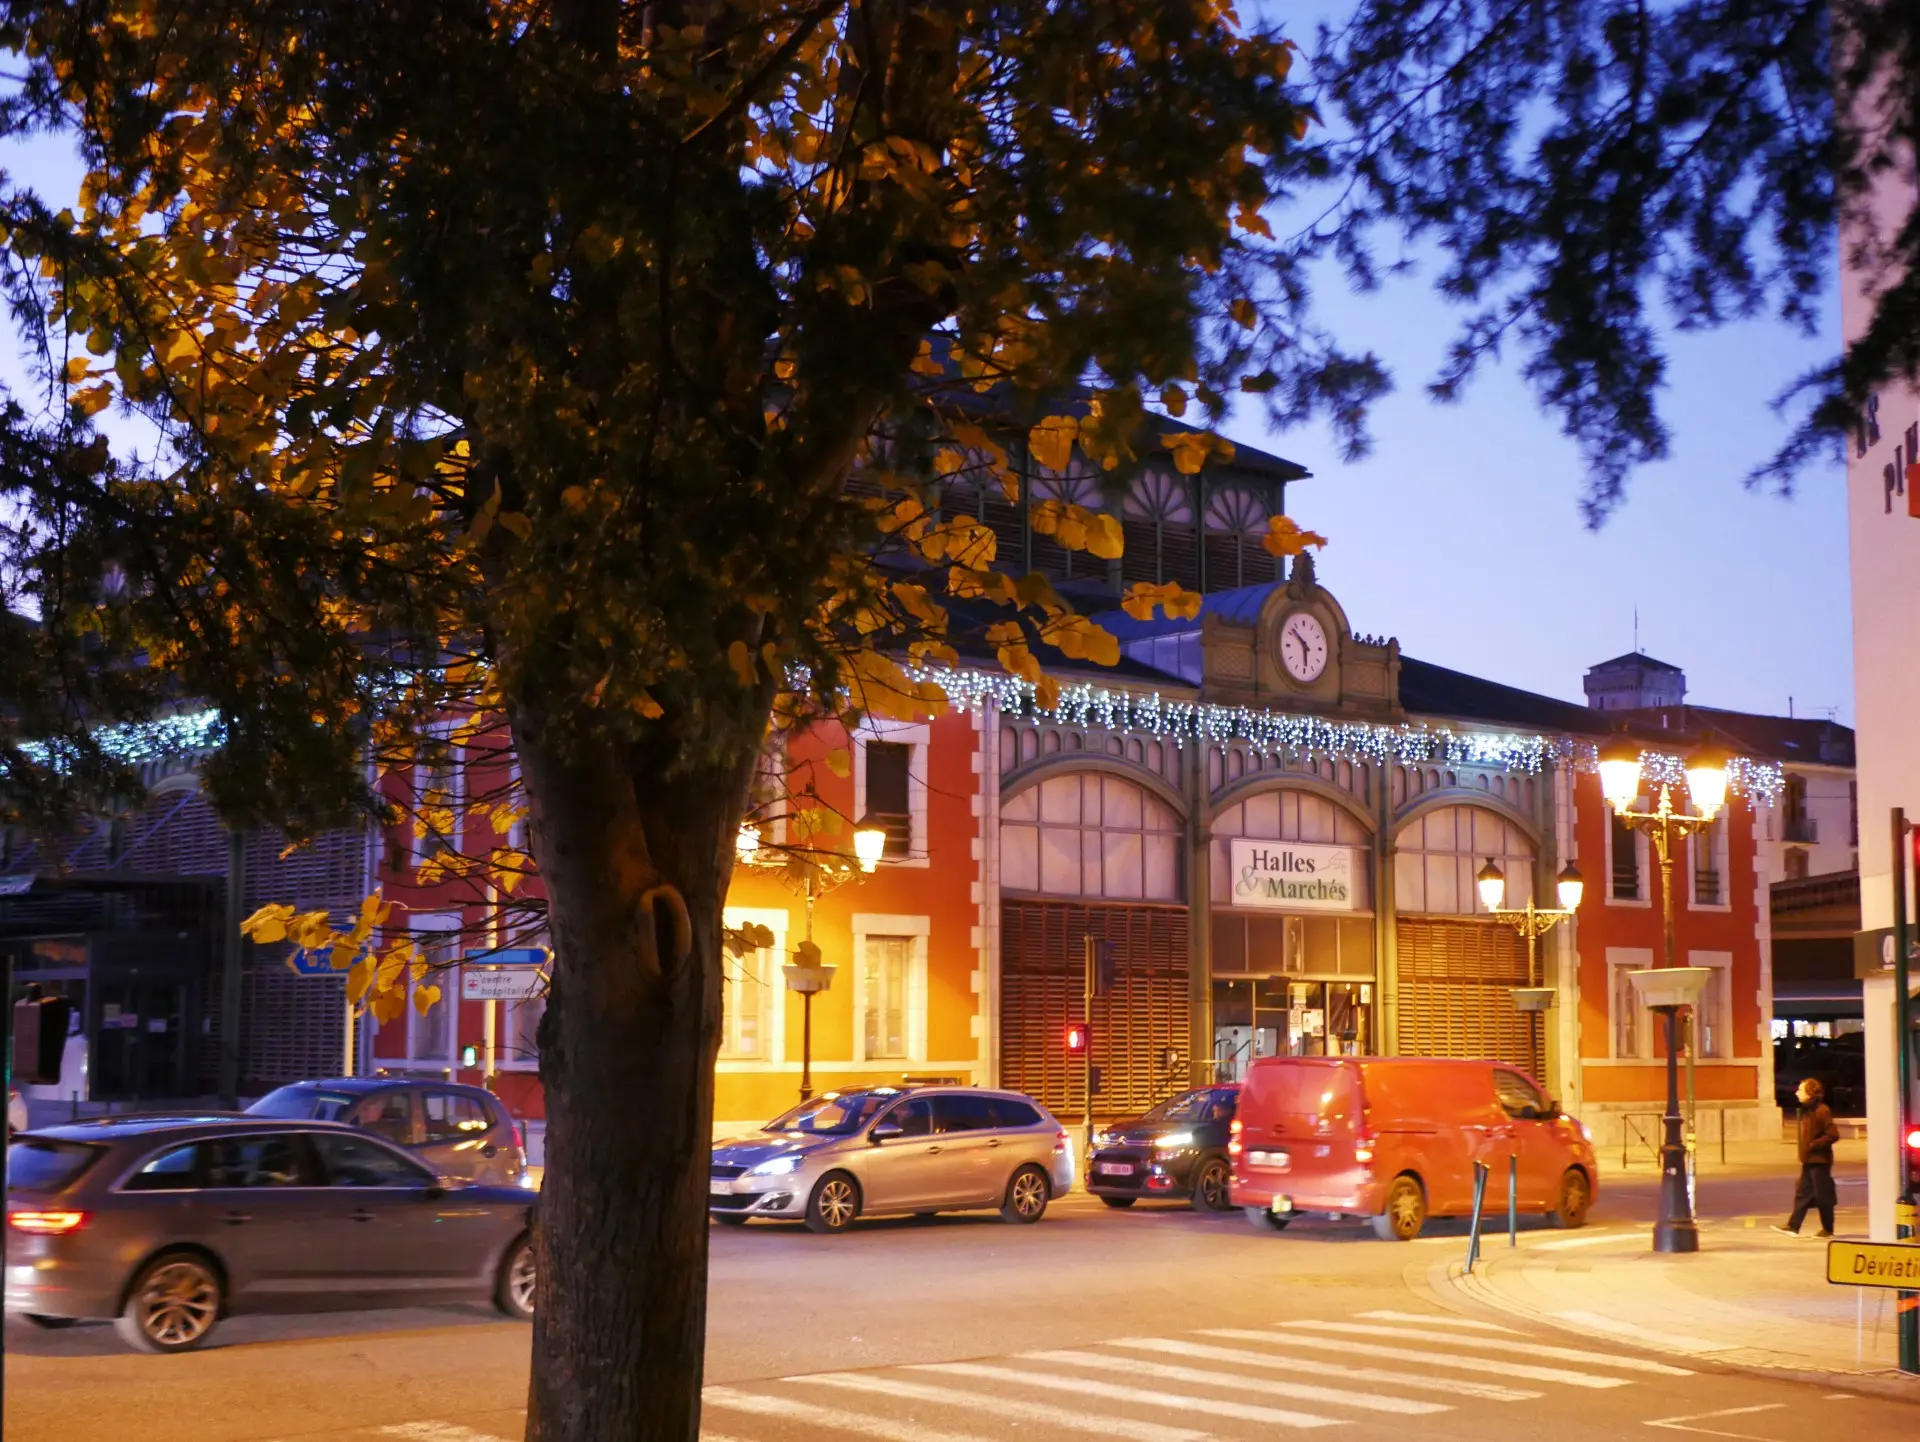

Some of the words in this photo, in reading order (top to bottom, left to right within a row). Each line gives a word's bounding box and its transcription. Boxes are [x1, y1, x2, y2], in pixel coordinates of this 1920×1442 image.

[1252, 849, 1315, 873] Halles
[1236, 865, 1263, 896] &
[1267, 878, 1347, 901] Marchés
[481, 975, 512, 984] centre
